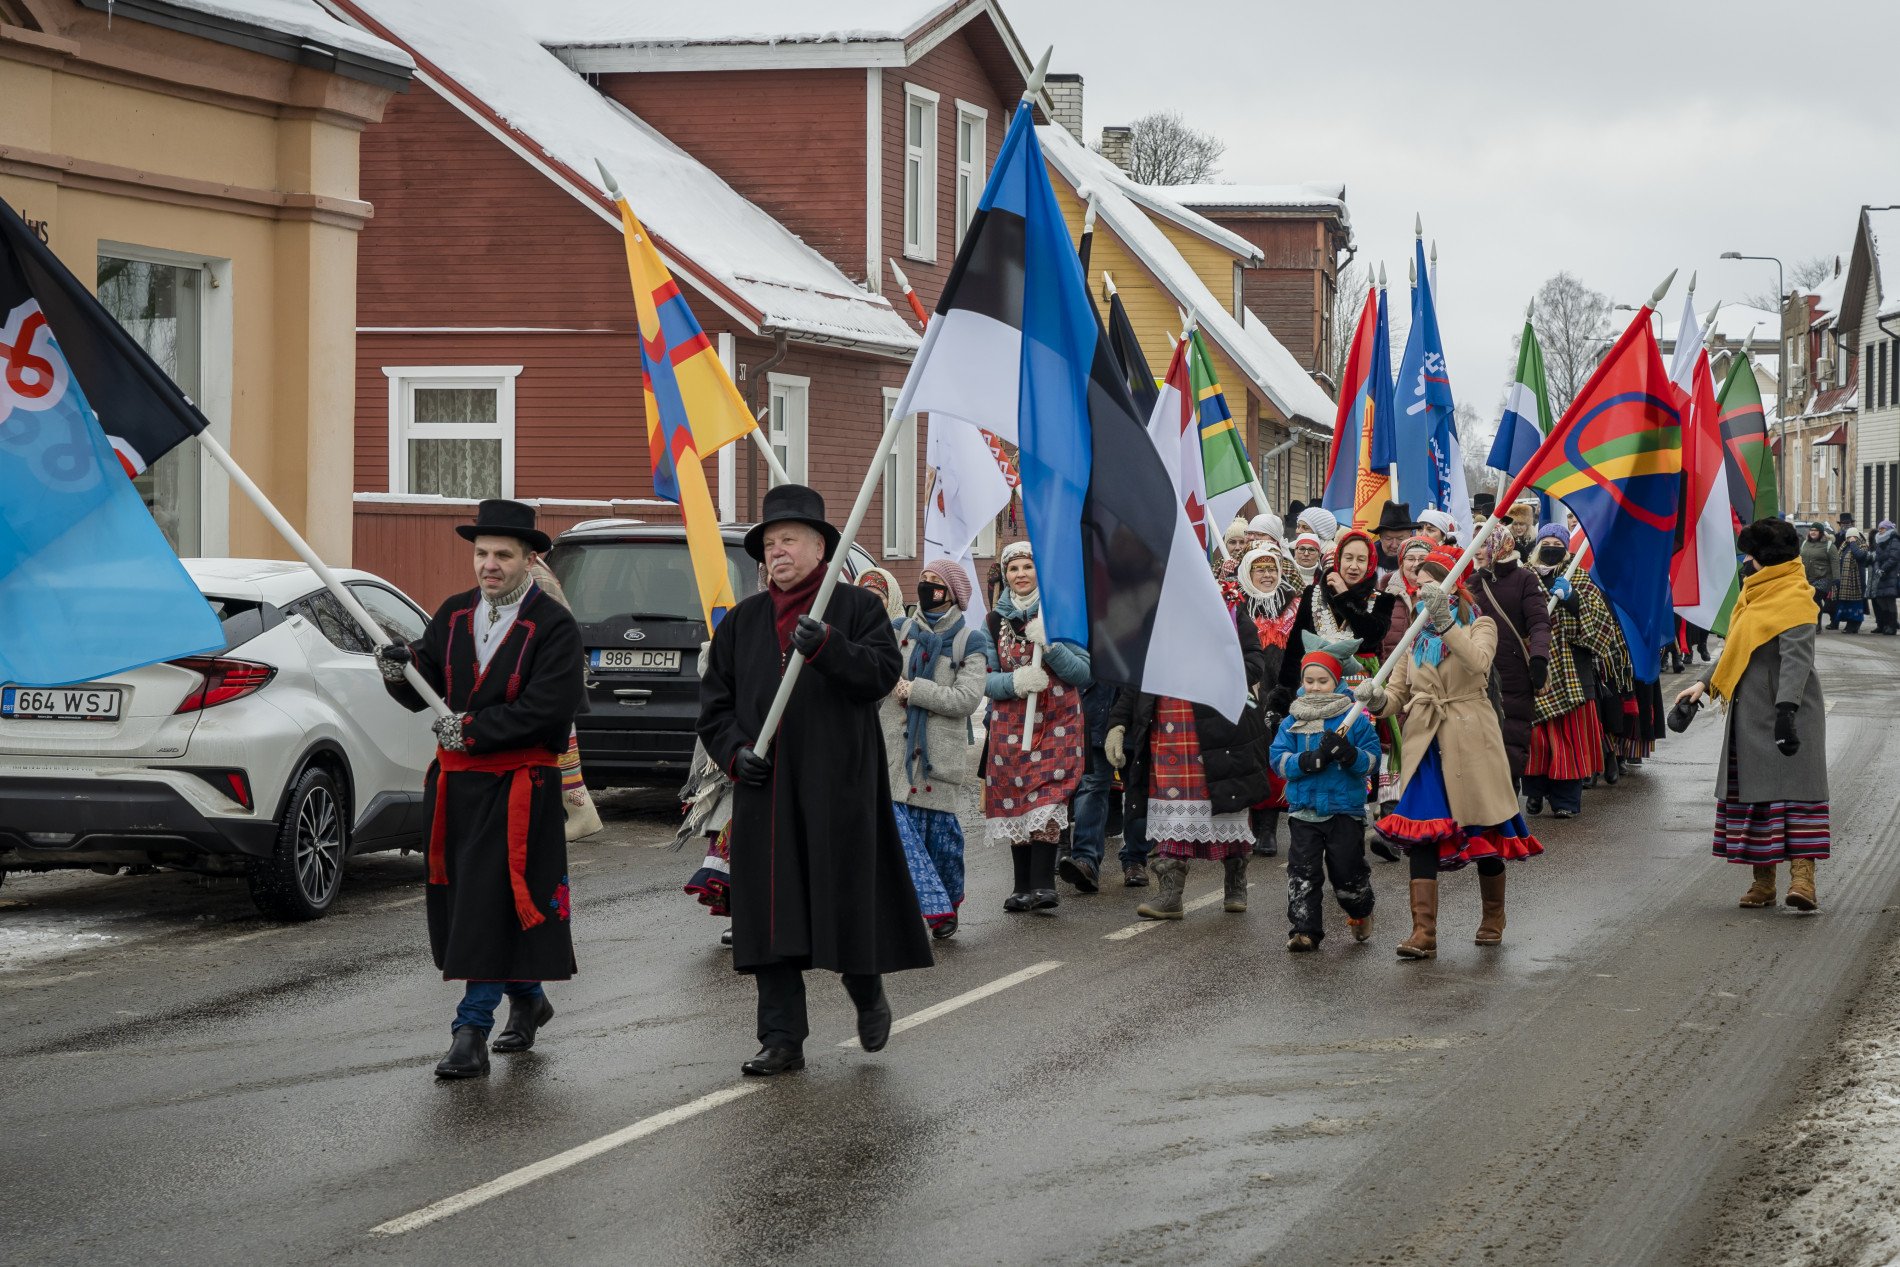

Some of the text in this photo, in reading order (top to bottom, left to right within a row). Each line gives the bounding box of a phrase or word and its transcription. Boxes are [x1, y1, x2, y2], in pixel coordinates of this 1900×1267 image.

[605, 652, 676, 666] 986 DCH
[20, 692, 114, 713] 664 WSJ
